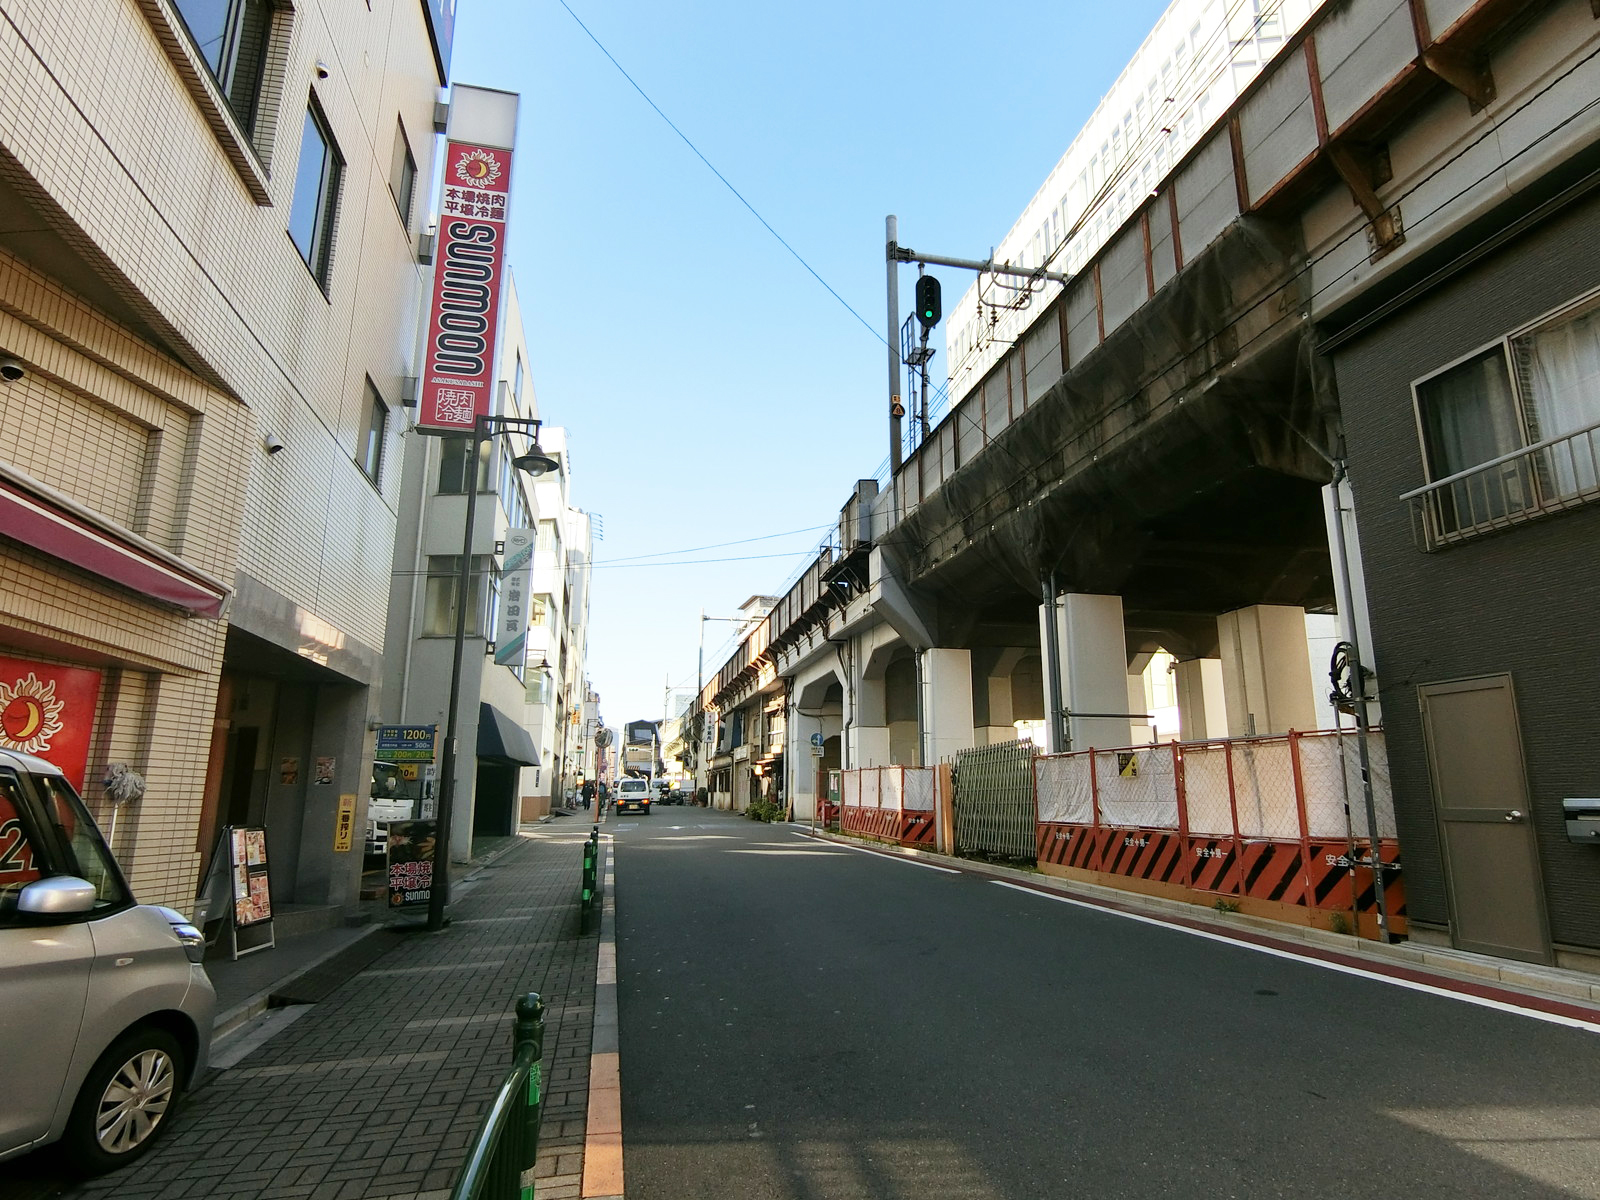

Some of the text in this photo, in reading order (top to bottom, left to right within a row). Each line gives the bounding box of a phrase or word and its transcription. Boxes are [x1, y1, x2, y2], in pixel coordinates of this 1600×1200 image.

[446, 188, 506, 207] 本場焼肉
[437, 389, 474, 407] 焼肉
[401, 769, 415, 777] 0円
[0, 818, 38, 873] 2
[389, 861, 434, 876] 本場焼
[389, 875, 433, 891] 平壌冷
[405, 890, 431, 901] sunmo
